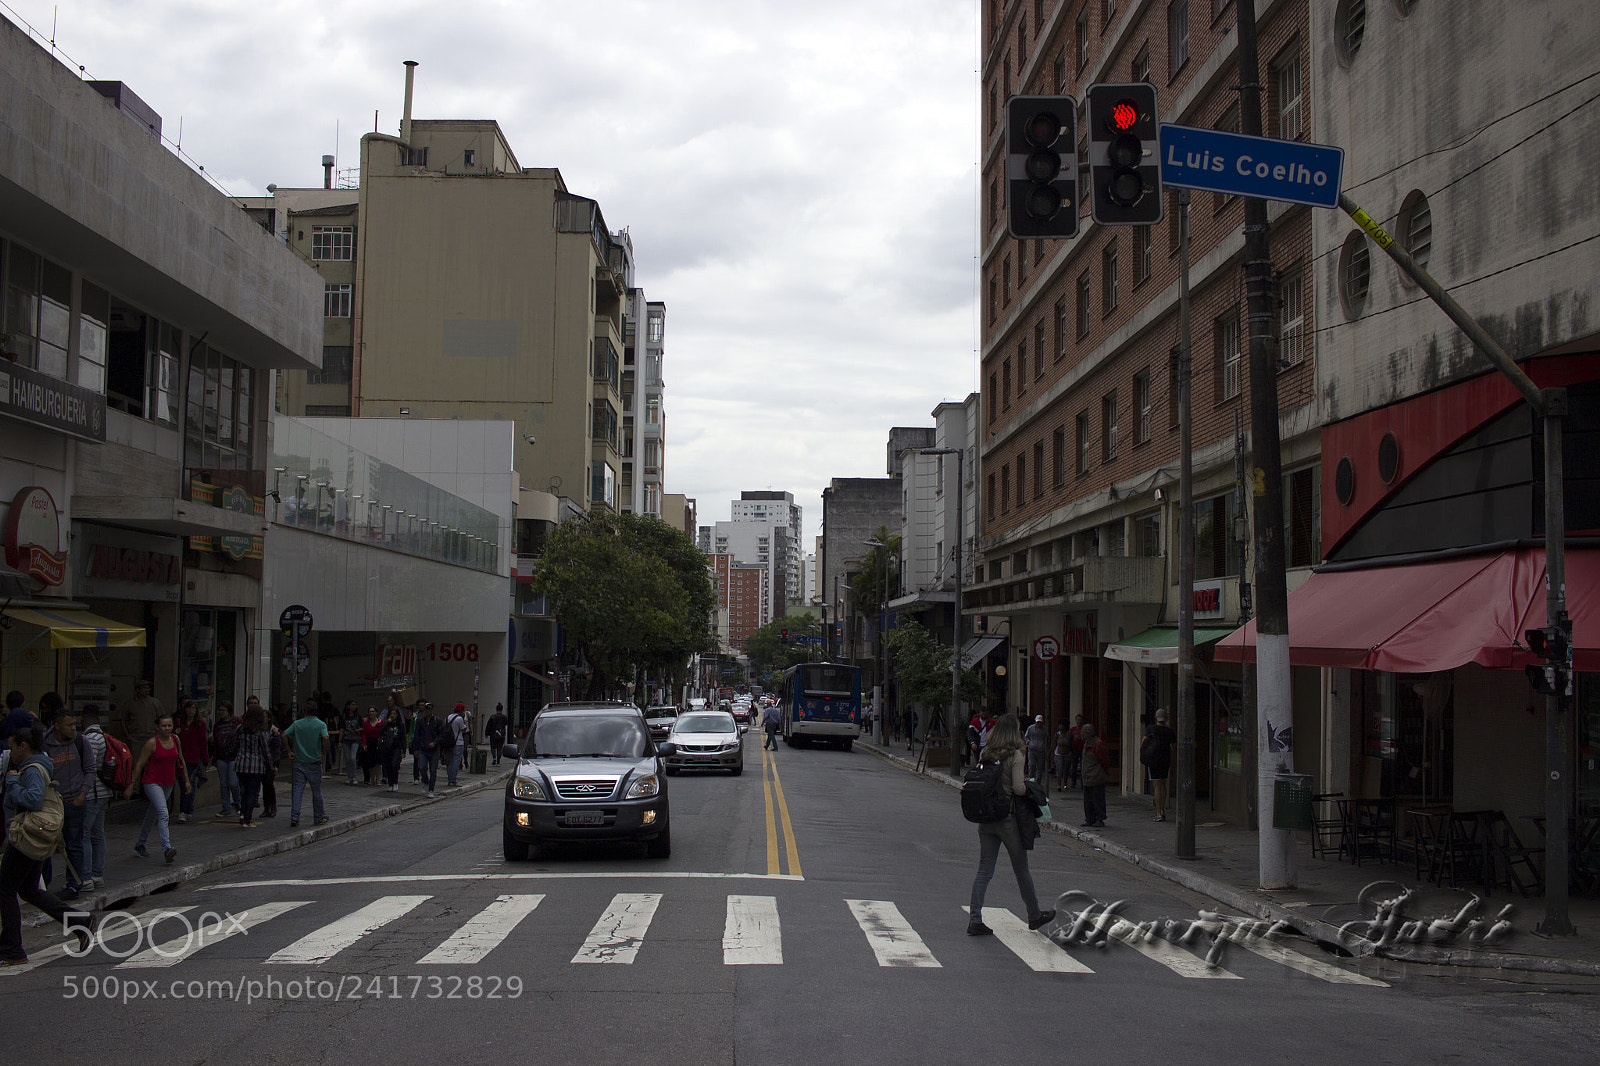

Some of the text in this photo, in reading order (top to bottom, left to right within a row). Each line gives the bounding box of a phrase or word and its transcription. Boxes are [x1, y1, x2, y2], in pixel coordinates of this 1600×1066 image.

[1167, 144, 1328, 187] Luis Coelho
[1363, 218, 1389, 245] 1705
[31, 495, 49, 511] Pastel
[88, 543, 181, 586] AUGUSTA
[426, 642, 479, 661] 1508
